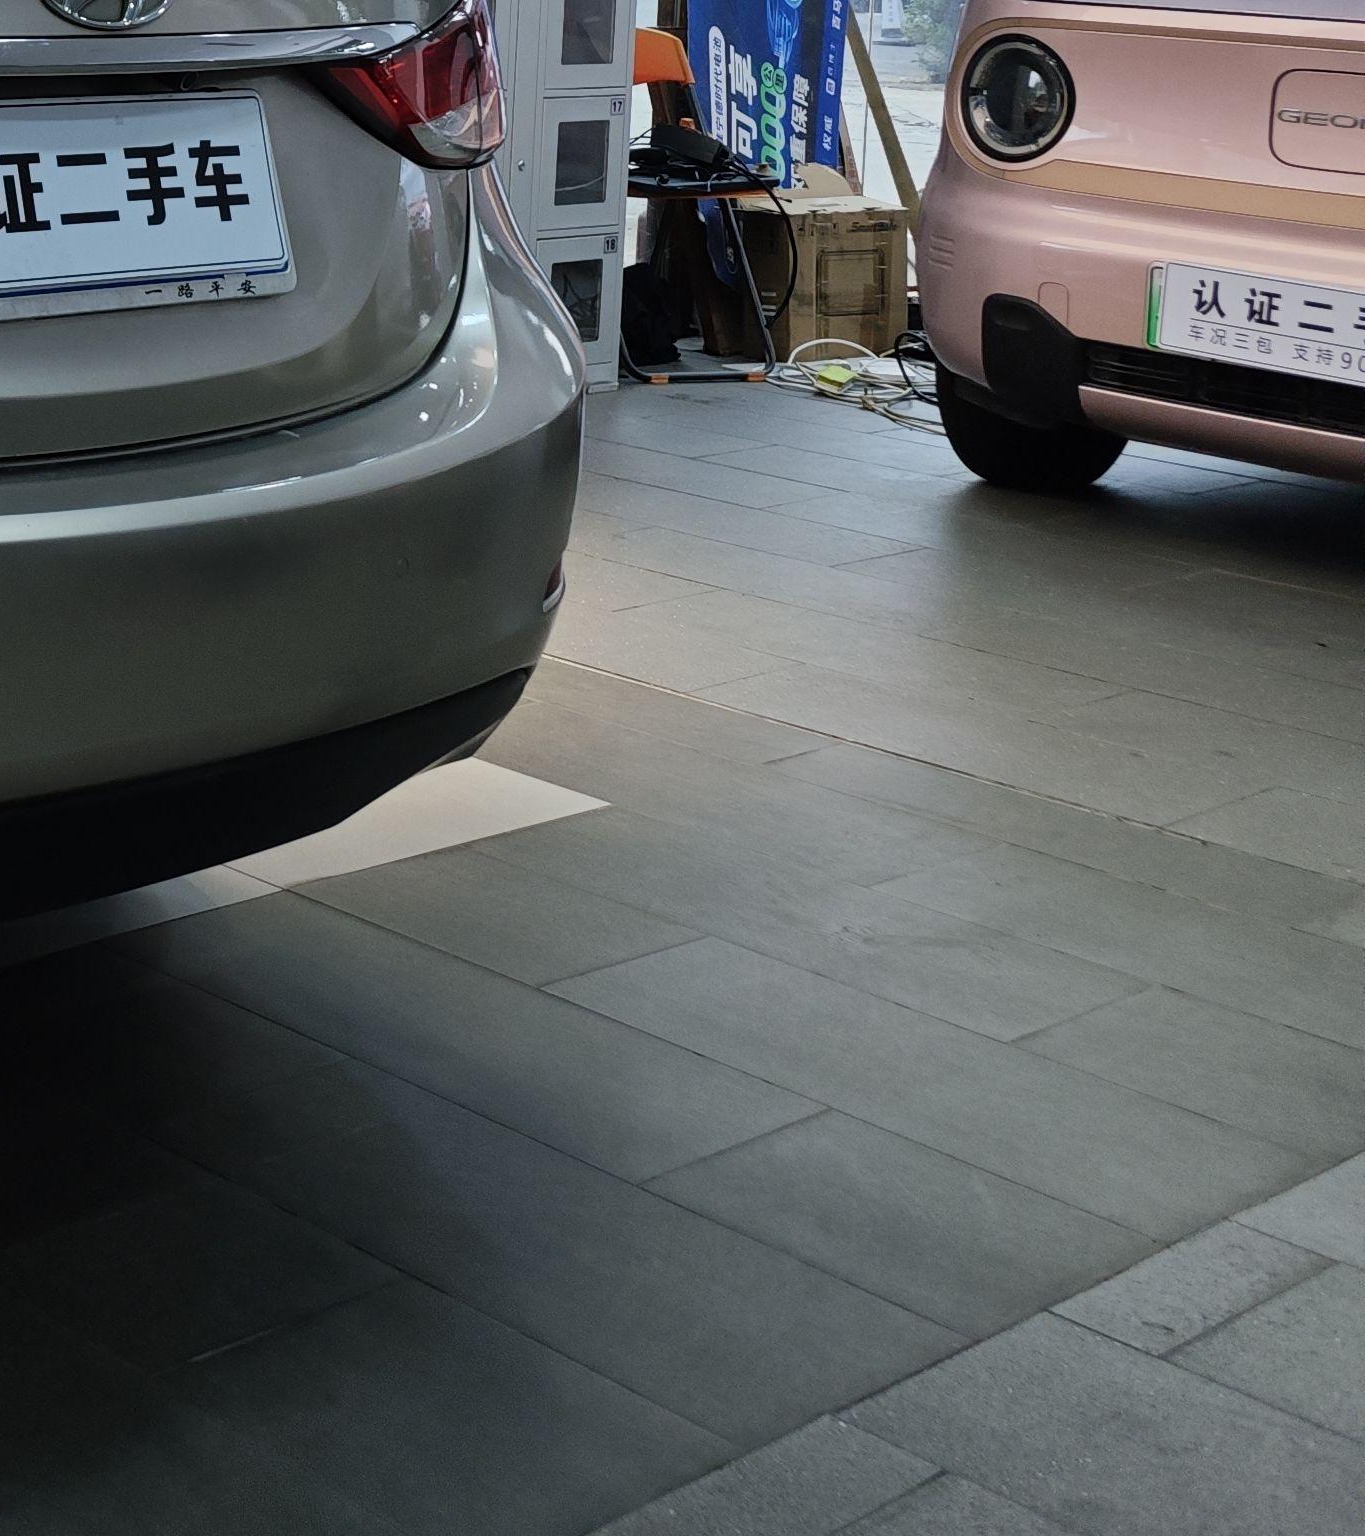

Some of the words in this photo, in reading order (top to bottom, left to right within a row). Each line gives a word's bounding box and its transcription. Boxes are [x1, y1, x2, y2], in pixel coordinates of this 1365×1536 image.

[612, 101, 623, 113] 17
[728, 44, 758, 157] 可享
[1277, 107, 1365, 130] GEO
[605, 239, 616, 251] 18
[143, 278, 257, 299] 一路平安
[1187, 324, 1273, 355] 车况三包
